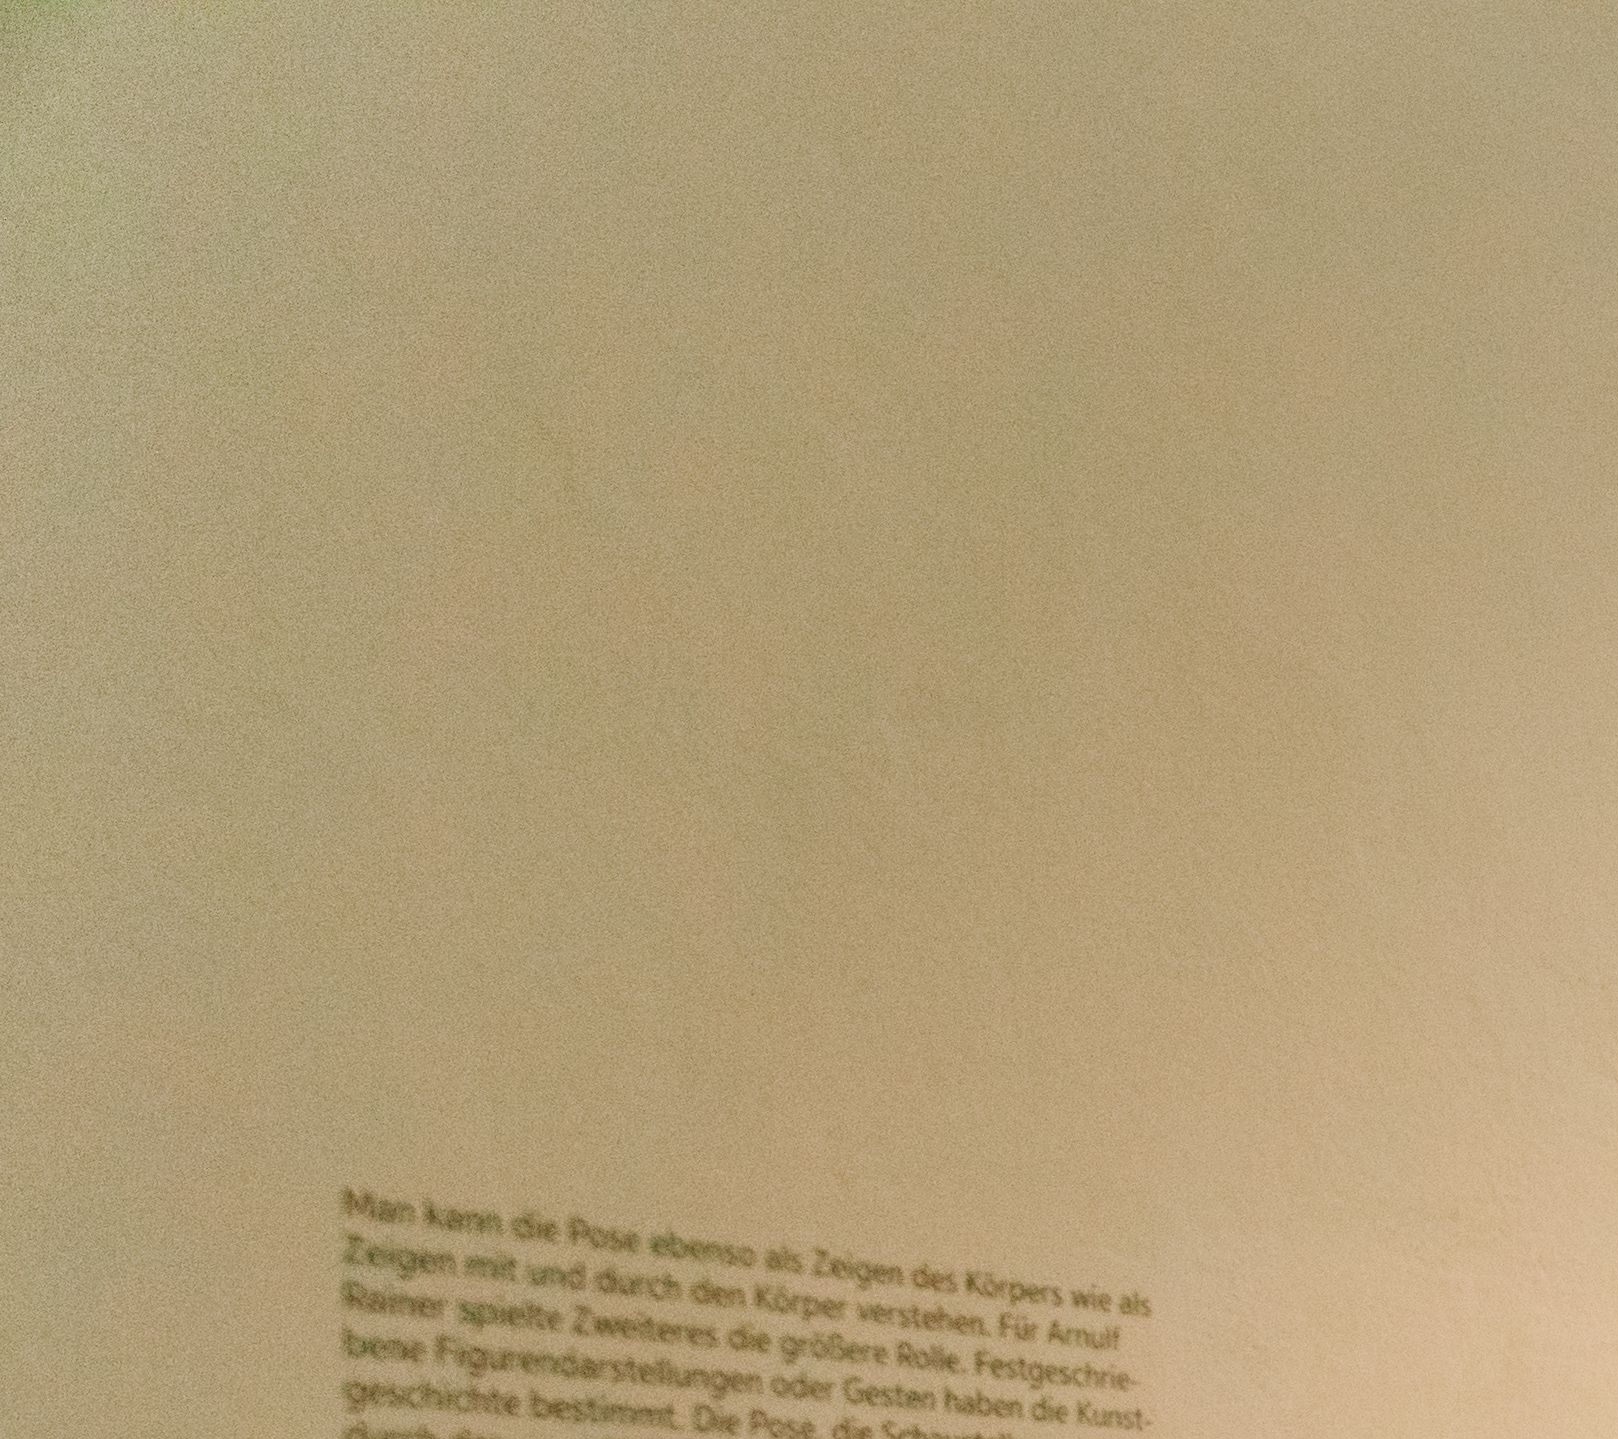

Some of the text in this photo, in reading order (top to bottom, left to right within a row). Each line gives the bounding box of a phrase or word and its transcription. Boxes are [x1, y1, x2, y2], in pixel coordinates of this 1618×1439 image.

[763, 1244, 1152, 1317] als Zeigen des Körpers wie als
[752, 1282, 1121, 1352] Körper verstehen. Für Arnulf
[725, 1322, 1139, 1391] die größere Rolle. Festgeschrie-
[769, 1370, 1150, 1431] oder Gesten haben die Kunst-
